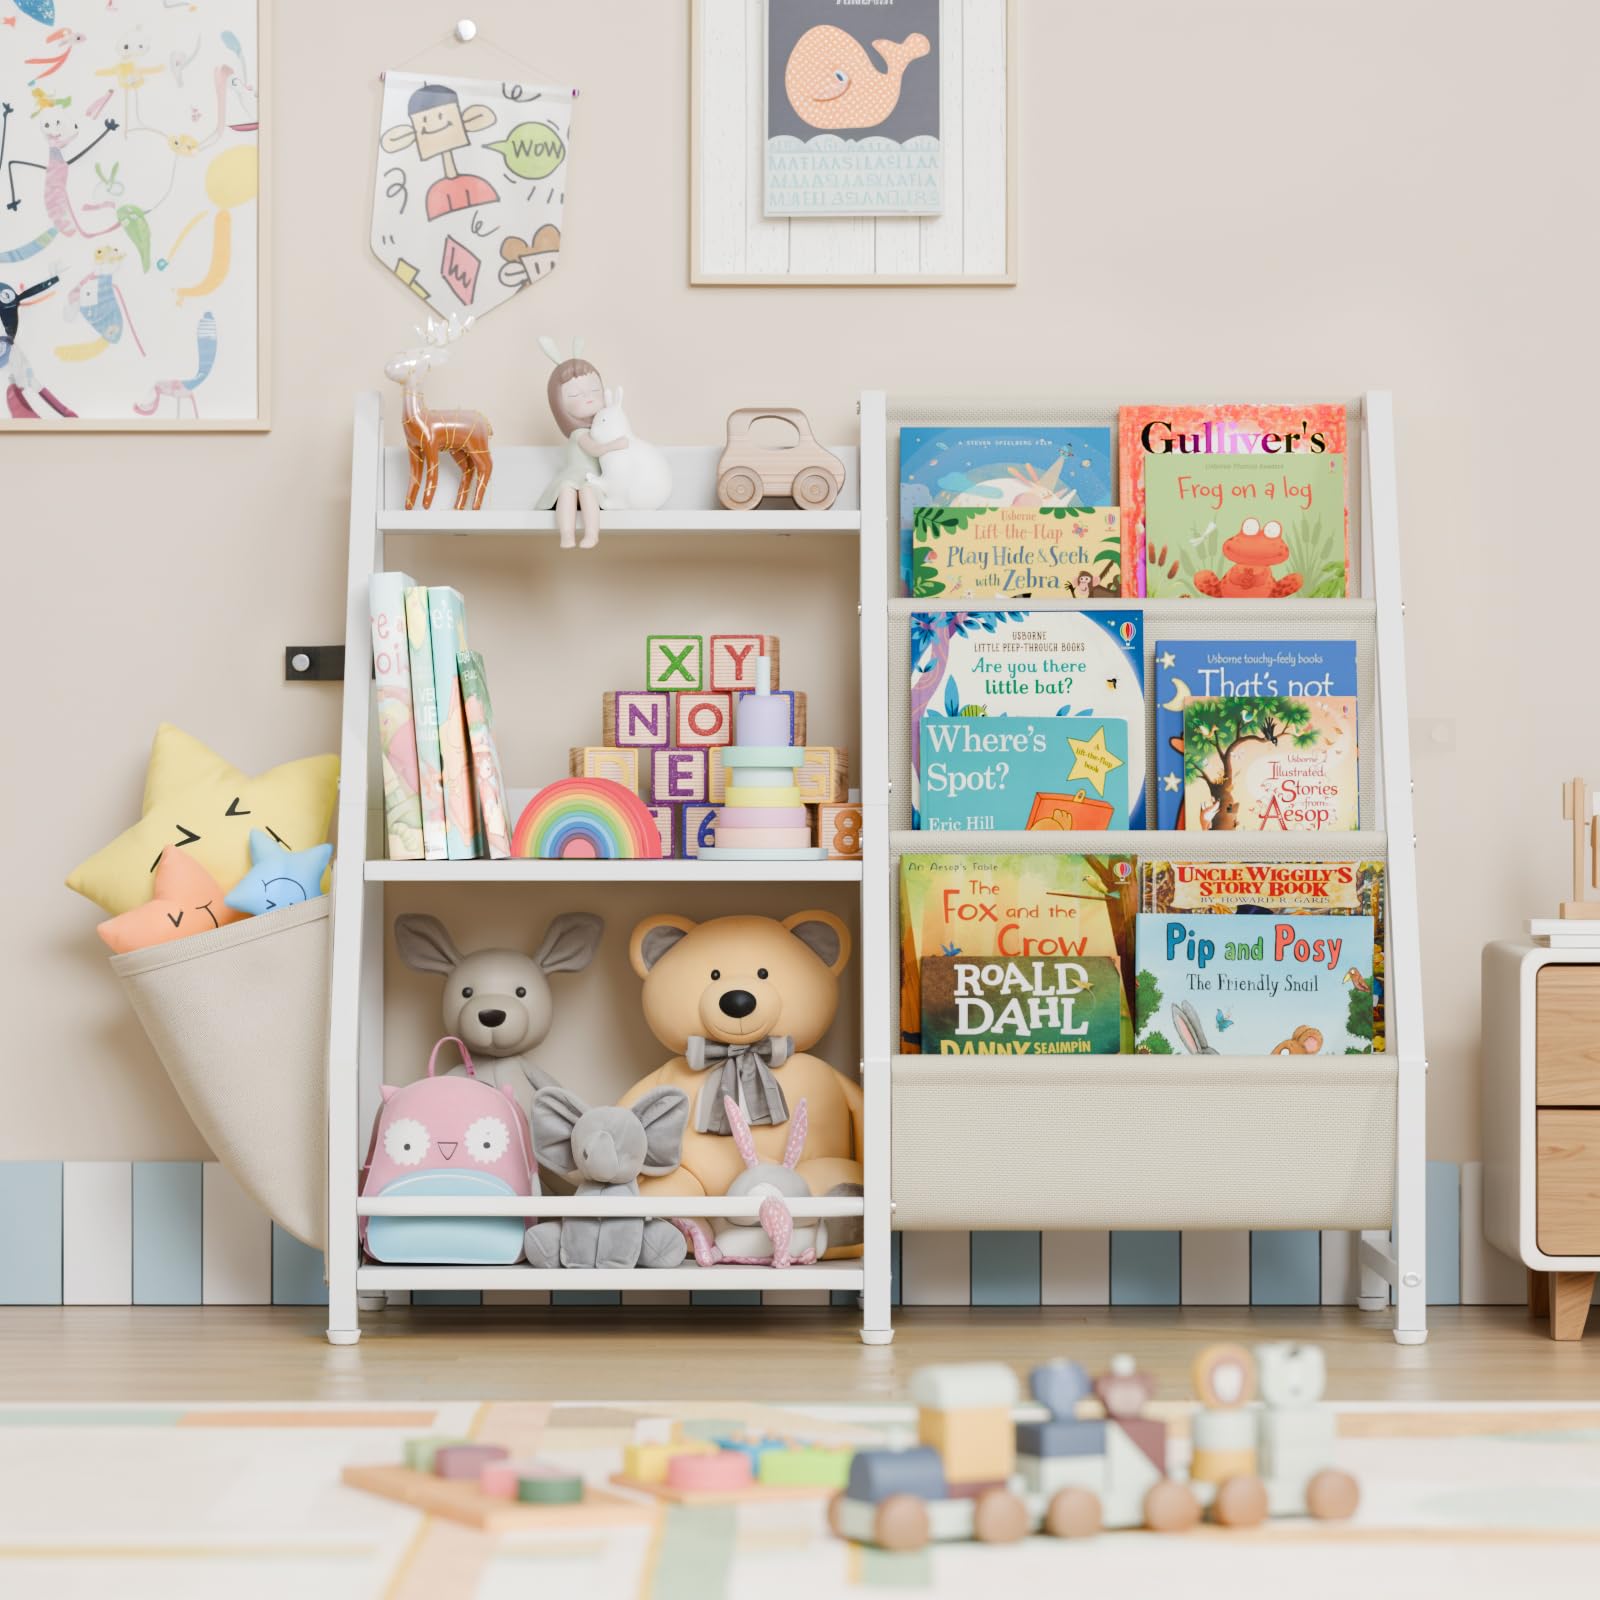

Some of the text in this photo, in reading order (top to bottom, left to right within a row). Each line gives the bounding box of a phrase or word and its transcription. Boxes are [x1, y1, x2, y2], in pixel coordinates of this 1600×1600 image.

[1141, 420, 1326, 454] Gulliver's
[1178, 475, 1312, 510] Frog on a log
[1001, 510, 1037, 522] Usborne
[975, 523, 1063, 544] Lift-the-Flap
[947, 545, 989, 570] Play
[992, 545, 1034, 566] Hide
[1048, 546, 1090, 567] Seek
[975, 568, 1060, 592] with Zebra
[974, 642, 1085, 652] LITTLE PEEP-THROUGH BOOKS
[1012, 631, 1047, 641] USBORNE
[656, 644, 697, 682] X
[724, 644, 755, 681] Y
[972, 657, 1086, 678] Are you there
[1207, 652, 1324, 668] Usborne touchy-feely books
[985, 677, 1074, 695] little bat?
[1197, 666, 1335, 697] That's not
[628, 703, 659, 737] N
[688, 702, 724, 736] O
[926, 724, 1047, 753] Where's
[668, 754, 694, 797] E
[1084, 761, 1098, 773] book
[1266, 761, 1325, 780] Illustrated
[927, 762, 1010, 798] Spot?
[1281, 779, 1338, 803] Stories
[928, 815, 995, 831] Eric Hill
[1258, 795, 1330, 831] Aesop
[908, 862, 924, 871] An
[930, 862, 967, 872] Aesop's
[1177, 866, 1244, 884] UNCLE
[969, 880, 1000, 896] The
[1200, 882, 1330, 898] STORY BOOK
[943, 889, 1078, 924] Fox and the
[998, 924, 1088, 958] Crow
[1166, 922, 1342, 970] Pip and Posy
[953, 961, 1089, 996] ROALD
[1186, 973, 1319, 998] The Friendly Snail
[954, 996, 1090, 1036] DAHL
